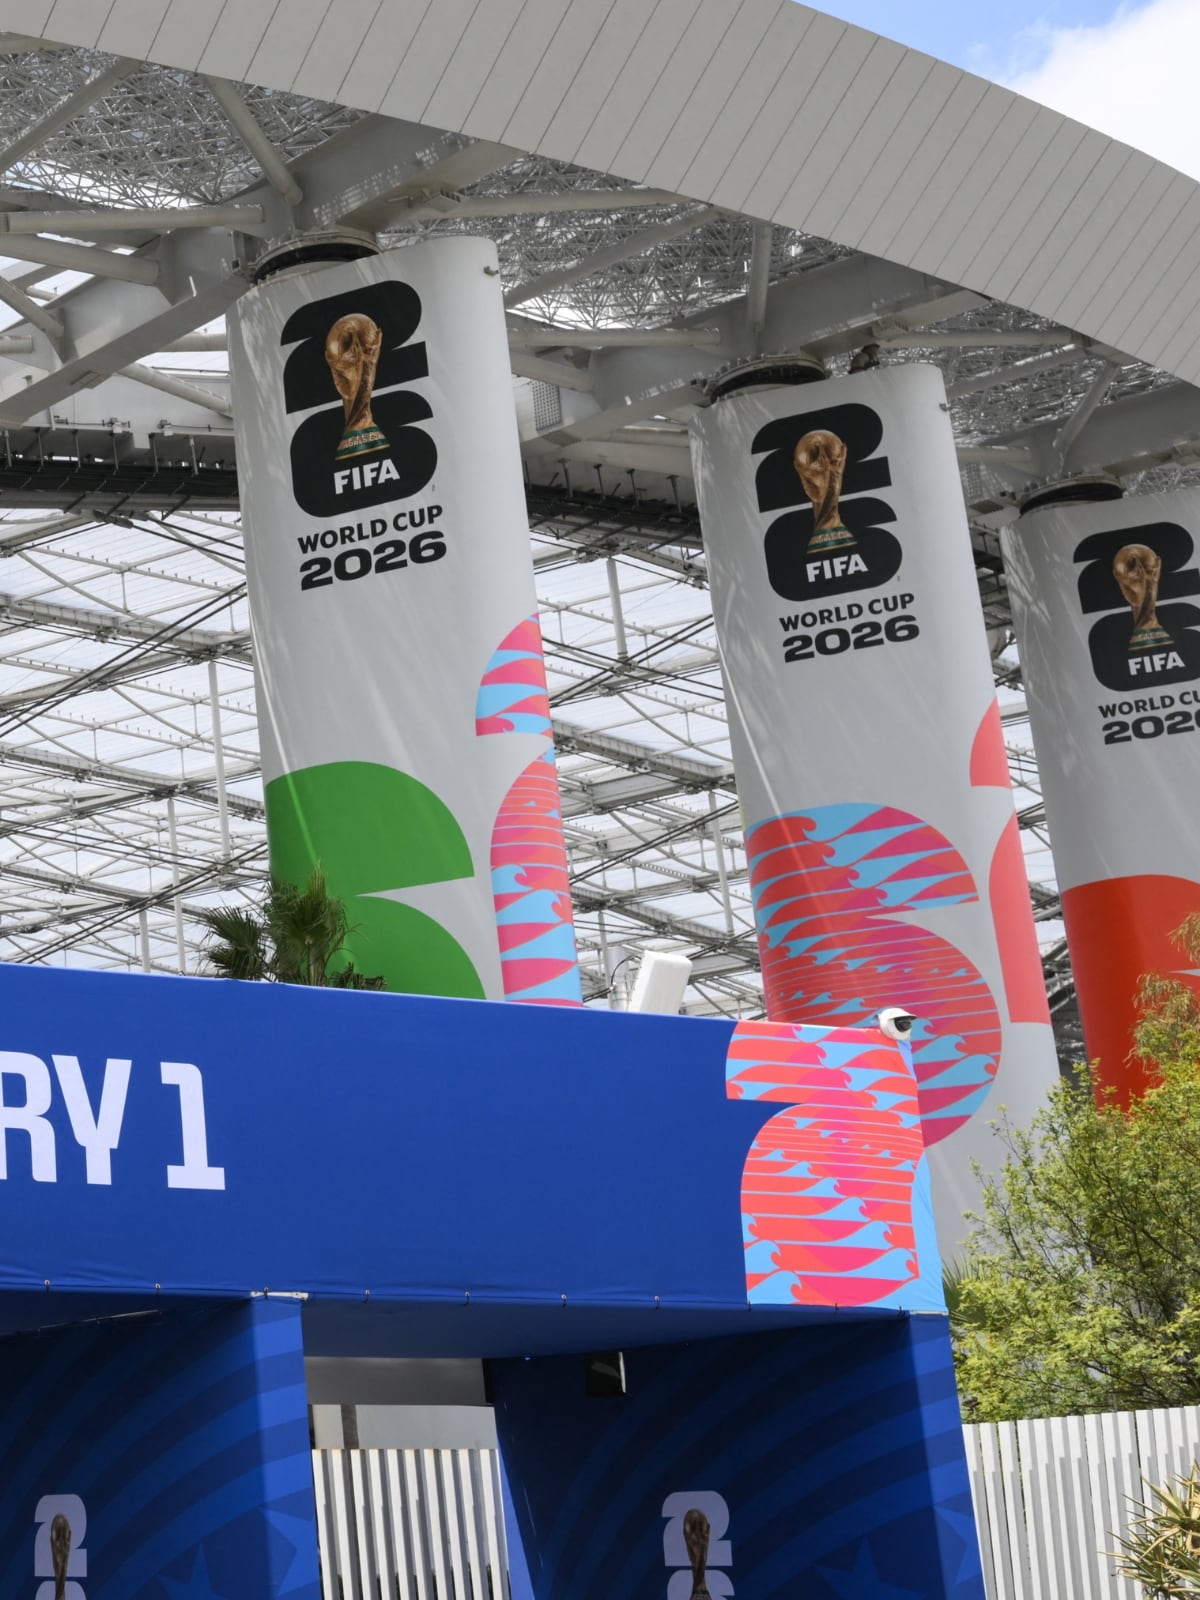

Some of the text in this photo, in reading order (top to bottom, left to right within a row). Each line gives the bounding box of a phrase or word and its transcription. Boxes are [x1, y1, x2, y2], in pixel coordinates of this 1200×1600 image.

[334, 459, 400, 494] FIFA
[298, 505, 443, 554] WORLD CUP
[300, 531, 446, 591] 2026
[806, 554, 868, 582] FIFA
[779, 593, 915, 632] WORLD CUP
[783, 615, 919, 663] 2026
[1128, 652, 1185, 675] FIFA
[1098, 690, 1200, 718] WORLD CU
[1103, 709, 1200, 745] 202
[160, 1062, 225, 1190] 1
